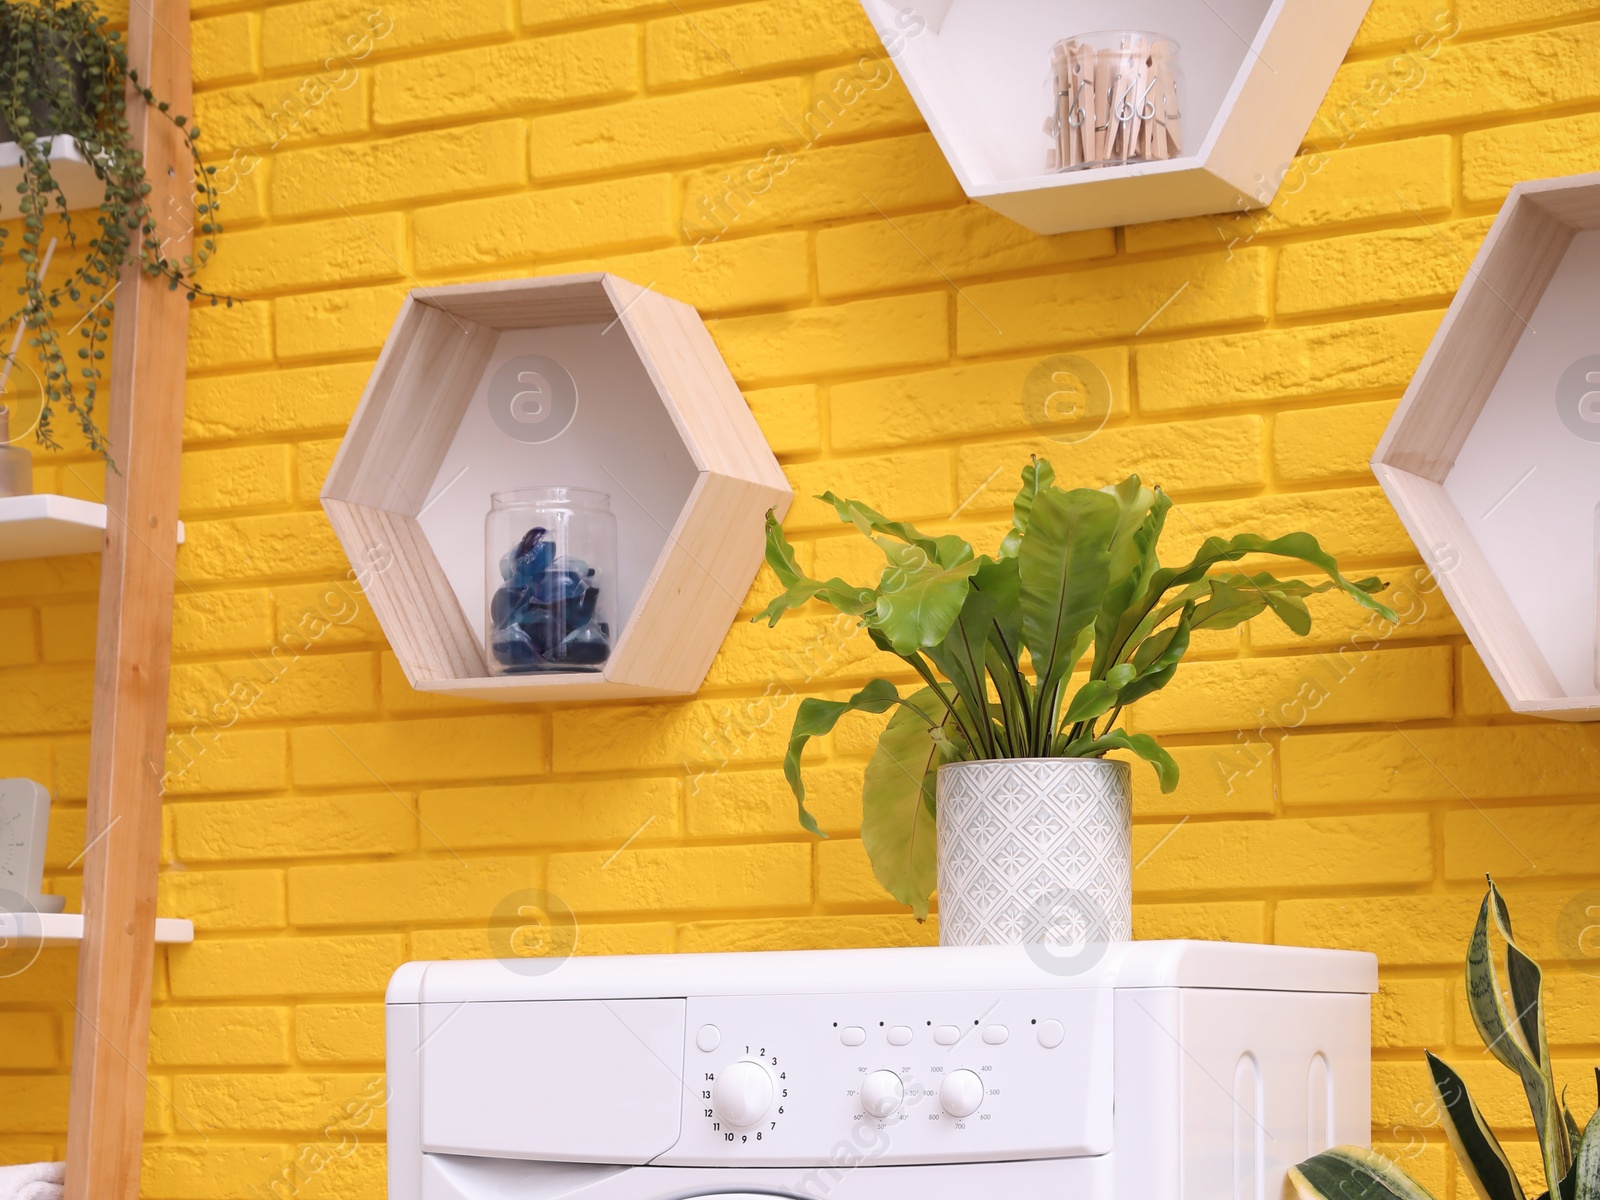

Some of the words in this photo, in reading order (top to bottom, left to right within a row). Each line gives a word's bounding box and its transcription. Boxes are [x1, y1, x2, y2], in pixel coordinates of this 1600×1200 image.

[745, 1046, 749, 1054] 1
[760, 1048, 765, 1056] 2
[772, 1057, 777, 1066] 3
[705, 1073, 714, 1081] 14
[780, 1072, 786, 1080] 4
[702, 1091, 711, 1099] 13
[782, 1089, 788, 1097] 5
[704, 1109, 713, 1117] 12
[778, 1106, 784, 1114] 6
[713, 1123, 720, 1131] 11
[771, 1122, 776, 1130] 7
[724, 1133, 734, 1141] 10
[741, 1135, 747, 1144] 9
[756, 1132, 762, 1140] 8
